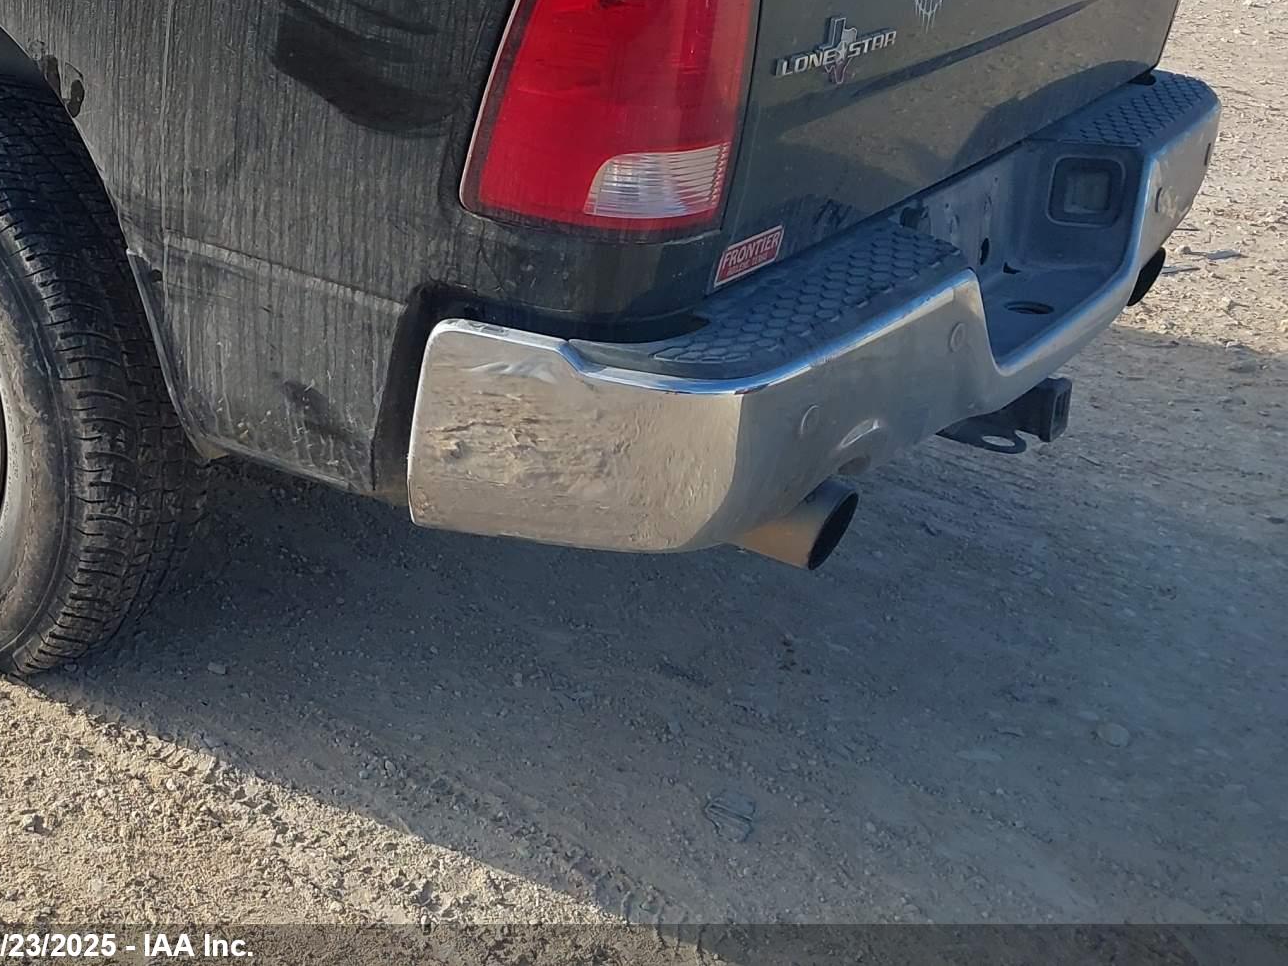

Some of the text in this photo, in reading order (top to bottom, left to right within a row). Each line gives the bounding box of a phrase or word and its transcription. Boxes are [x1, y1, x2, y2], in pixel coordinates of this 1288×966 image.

[778, 30, 897, 76] LONE STAR
[722, 231, 781, 270] FRONTIER
